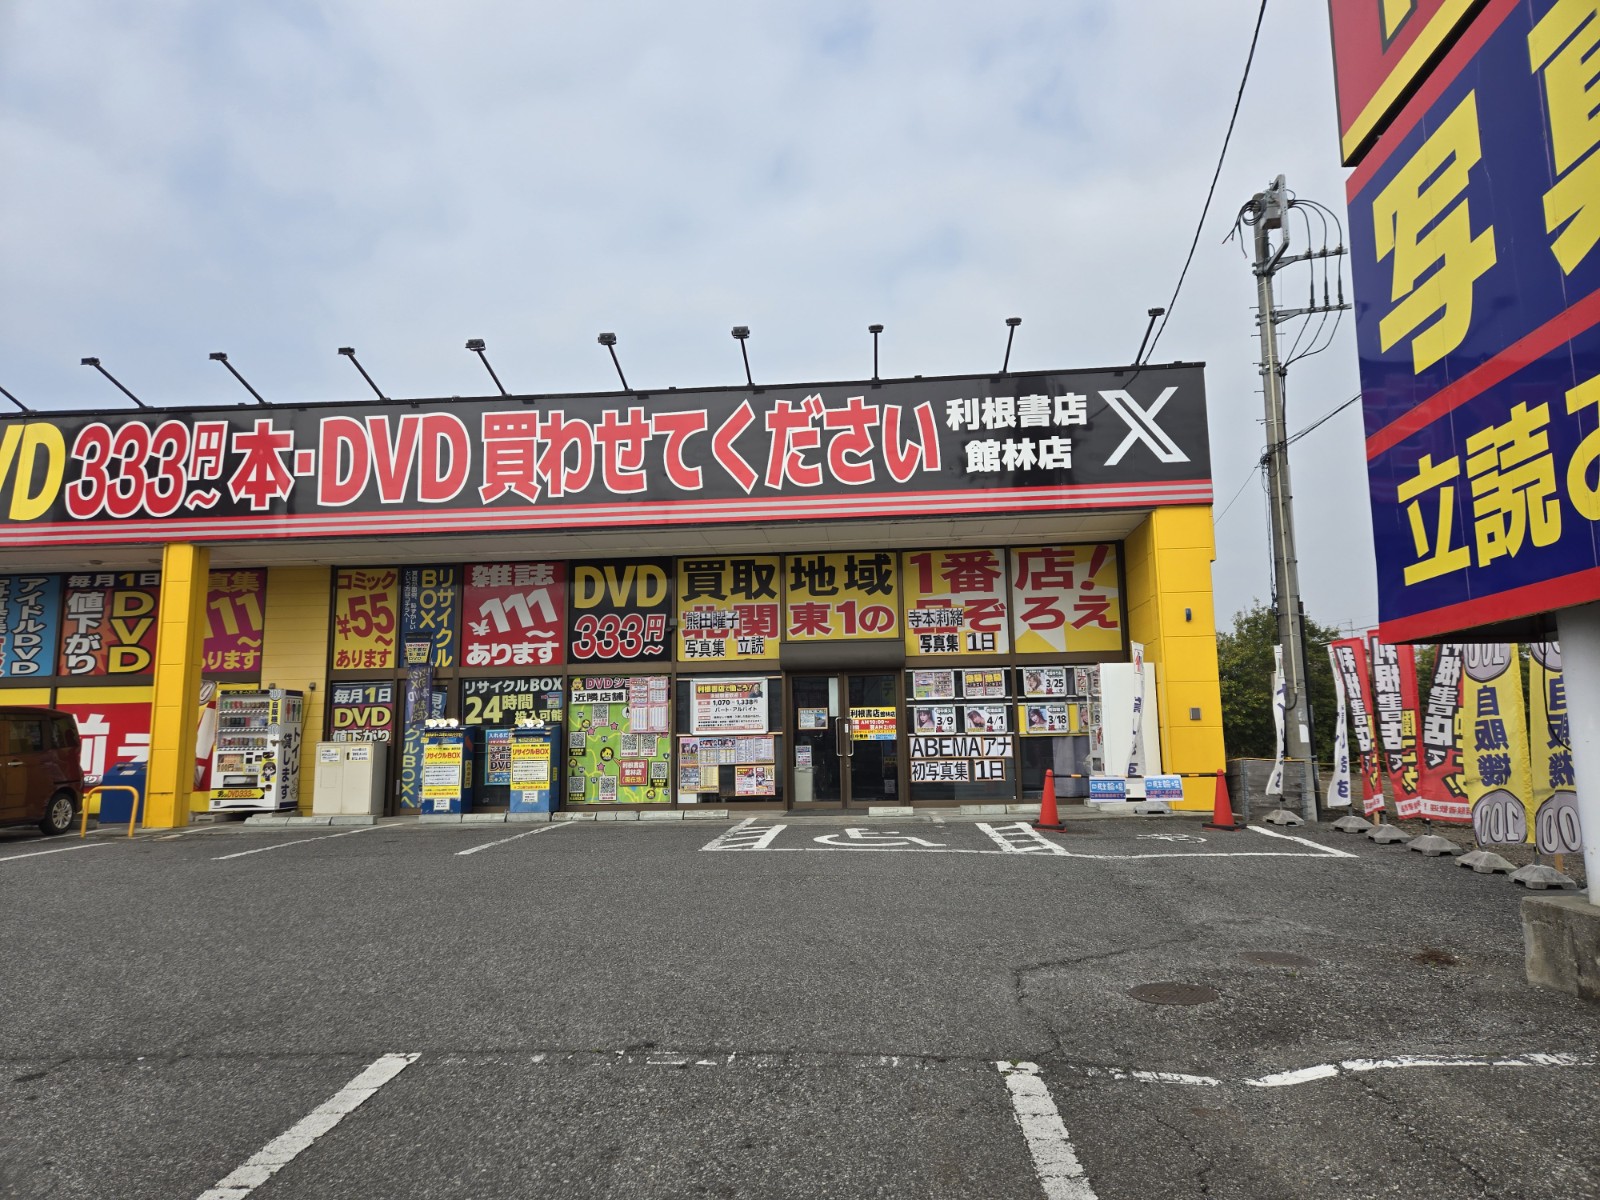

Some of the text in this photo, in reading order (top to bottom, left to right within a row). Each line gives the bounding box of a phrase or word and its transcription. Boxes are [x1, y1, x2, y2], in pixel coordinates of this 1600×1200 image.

[946, 392, 1088, 432] 利根書店
[478, 393, 941, 506] 買わせてください
[966, 435, 1072, 473] 館林店
[472, 564, 555, 587] 雑誌
[682, 559, 778, 601] 買取
[790, 554, 893, 597] 地域
[909, 550, 1002, 594] 1番
[1015, 545, 1110, 592] 店!
[67, 573, 160, 589] 毎月1日
[337, 571, 397, 591] コミック
[574, 564, 668, 609] DVD
[419, 569, 437, 629] BOX
[435, 568, 455, 668] リサイクル
[685, 610, 740, 630] 熊田曜子
[789, 601, 895, 635] 東1の
[908, 608, 964, 628] 寺本莉緒
[1020, 595, 1119, 630] ろえ
[11, 578, 48, 675] アイドルDVD
[65, 592, 104, 675] 値下がり
[108, 591, 155, 674] DVD
[466, 642, 559, 665] あります
[685, 636, 765, 657] 写真集 立読
[919, 633, 995, 652] 写真集 1日
[336, 649, 392, 668] あります
[465, 677, 563, 694] リサイクルBOX
[1046, 678, 1064, 689] 3/25
[334, 687, 392, 704] 毎月1日
[574, 692, 624, 702] 近隣店舗
[334, 707, 391, 728] DVD
[465, 693, 534, 725] 24時間
[850, 709, 880, 718] 利根書店
[987, 715, 1004, 725] 4/1
[1048, 714, 1067, 725] 3/18
[936, 716, 954, 726] 3/9
[291, 727, 301, 775] トイレ
[281, 732, 292, 799] 貸します
[911, 760, 1004, 781] 初写真集 1日
